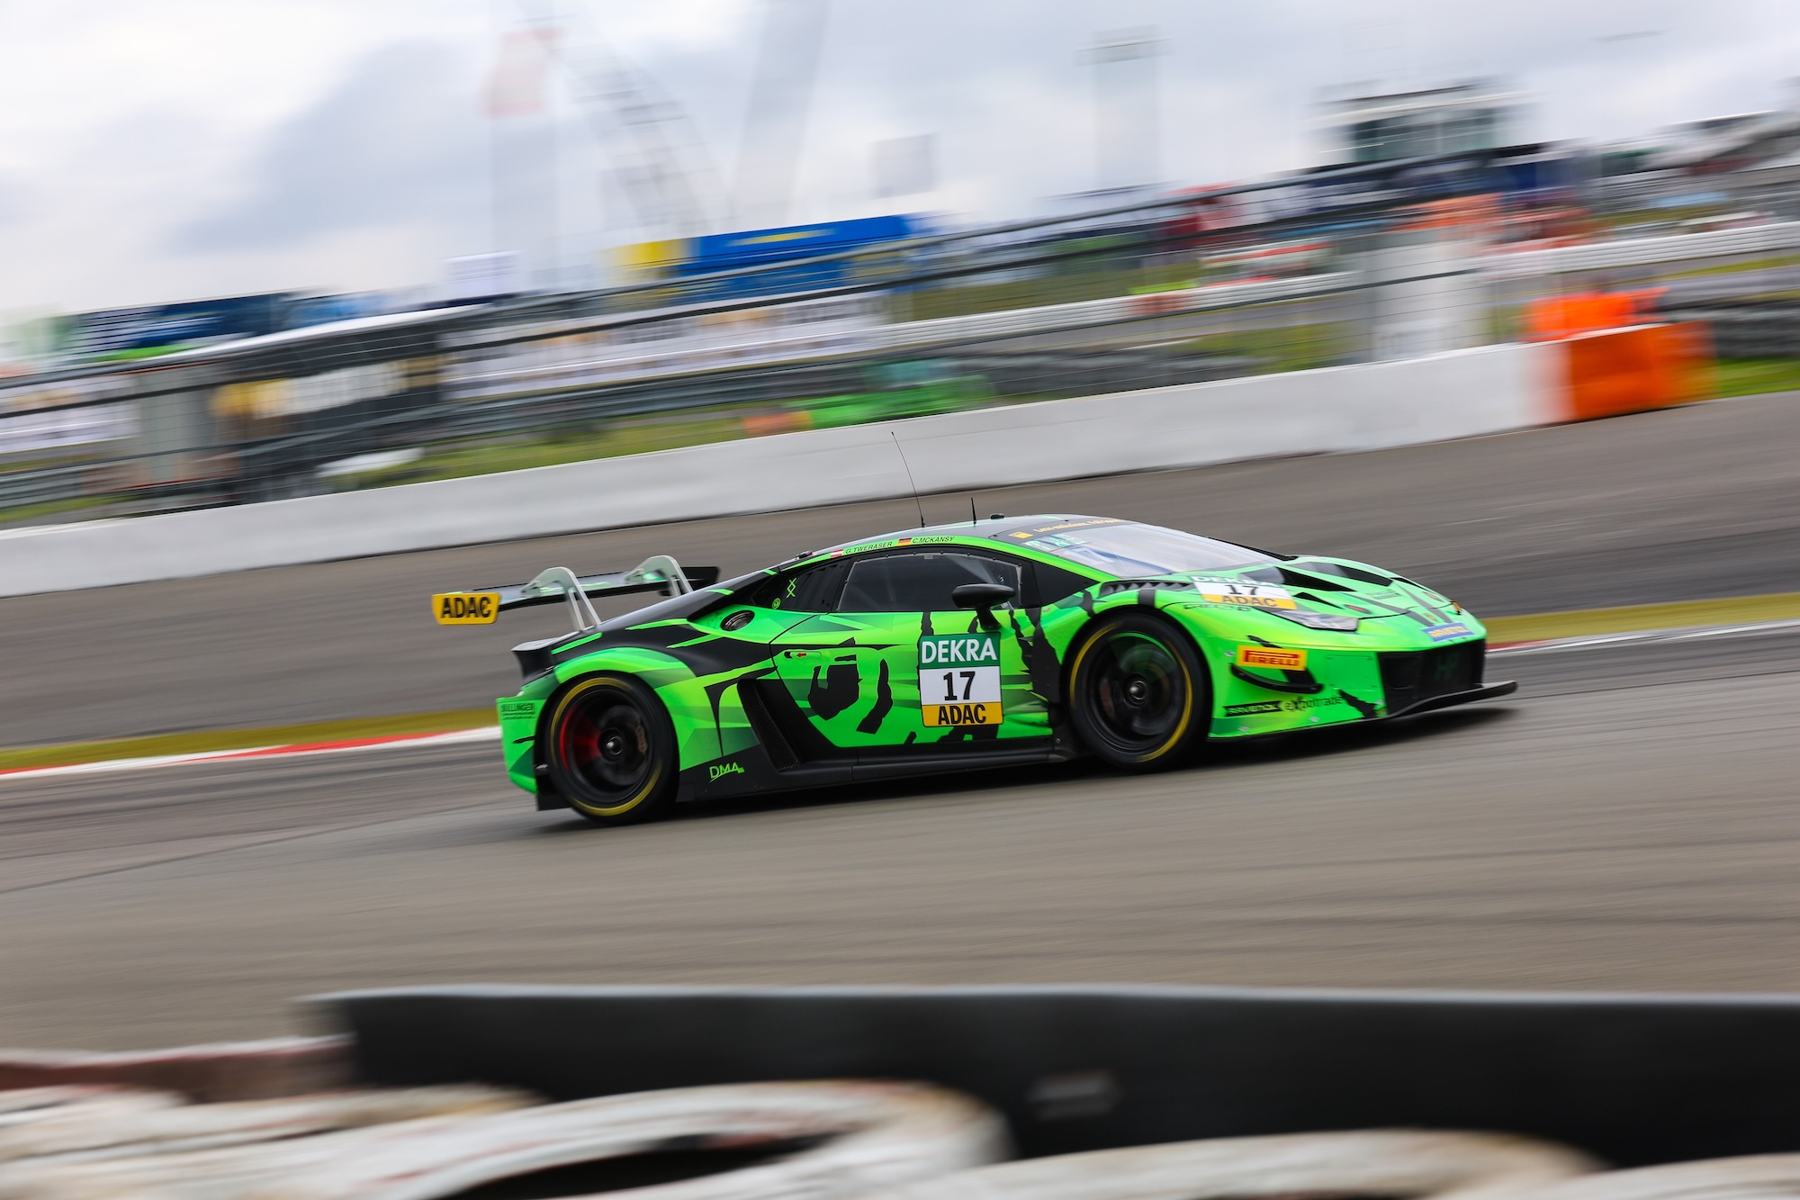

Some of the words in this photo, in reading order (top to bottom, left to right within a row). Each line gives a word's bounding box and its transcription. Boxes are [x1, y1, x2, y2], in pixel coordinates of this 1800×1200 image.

[1225, 584, 1259, 596] 17
[440, 596, 492, 619] ADAC
[1222, 595, 1278, 607] ADAC
[921, 637, 998, 664] DEKRA
[1244, 650, 1300, 667] PIRELLI
[943, 670, 976, 701] 17
[938, 703, 987, 725] ADAC
[709, 761, 739, 780] DMA
